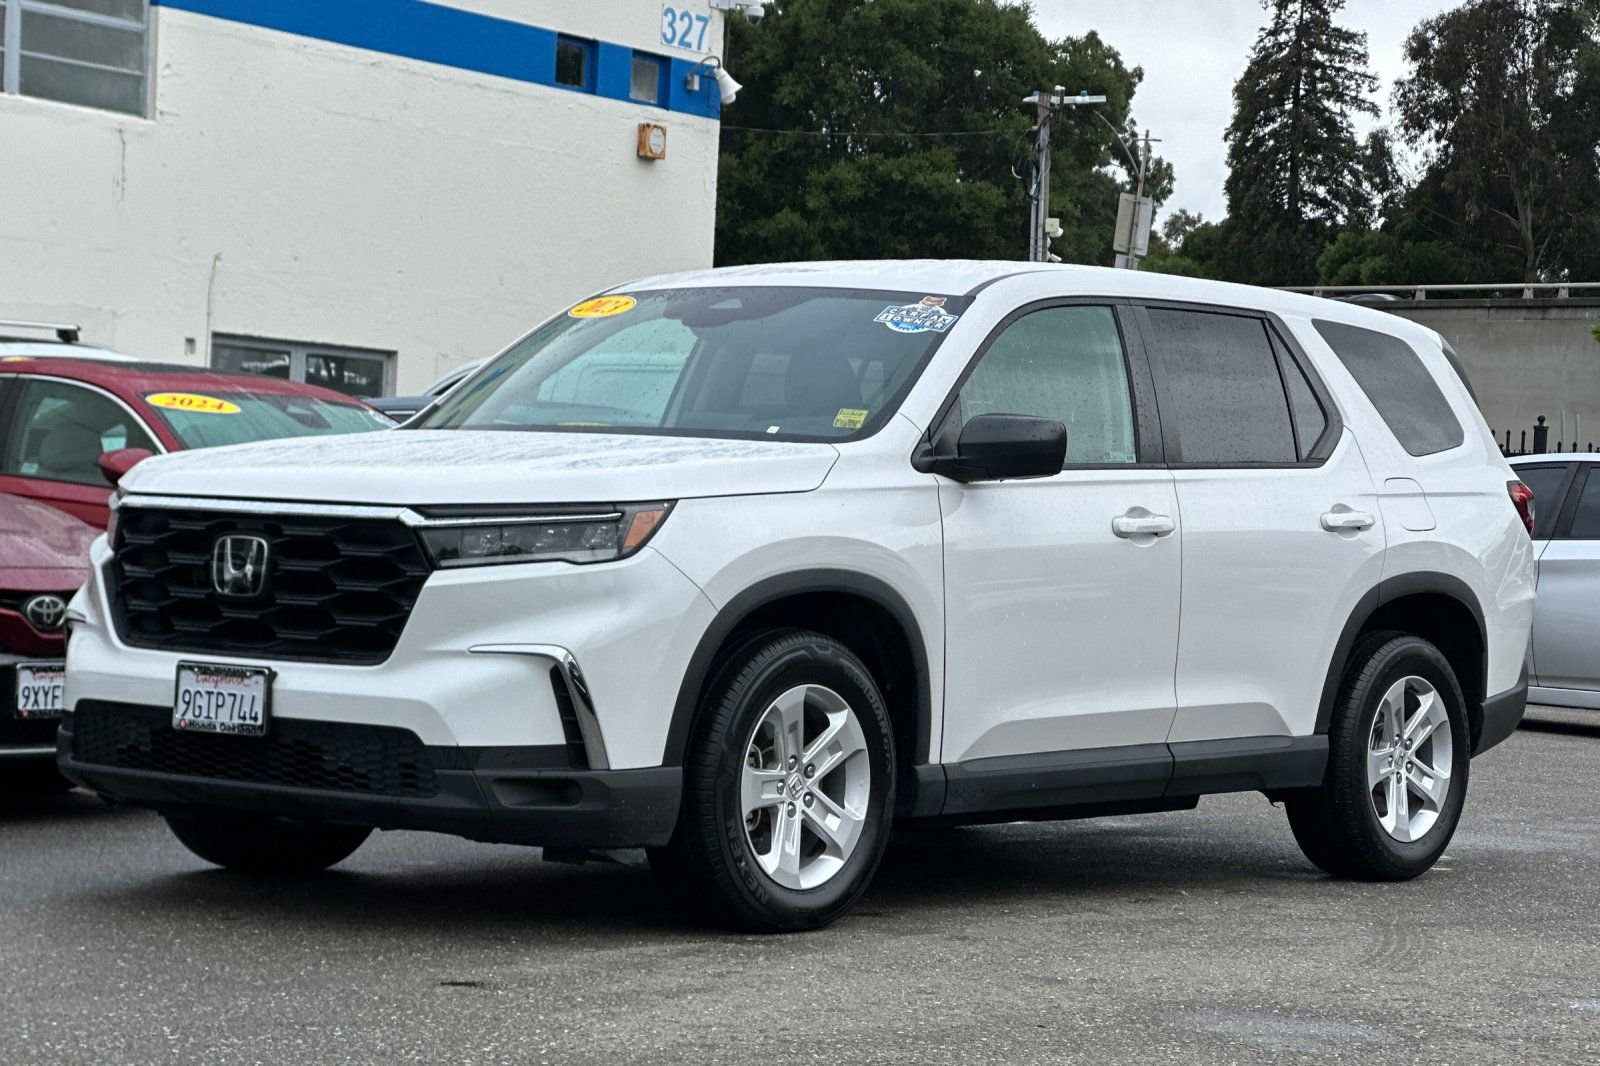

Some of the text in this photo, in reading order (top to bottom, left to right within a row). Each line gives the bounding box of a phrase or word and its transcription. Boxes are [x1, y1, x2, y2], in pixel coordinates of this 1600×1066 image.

[662, 7, 709, 50] 327
[888, 307, 953, 323] CARFAX
[892, 316, 944, 329] OWNER
[164, 396, 225, 411] 2024
[21, 685, 64, 708] 9XYF
[181, 688, 259, 723] 9GIP744
